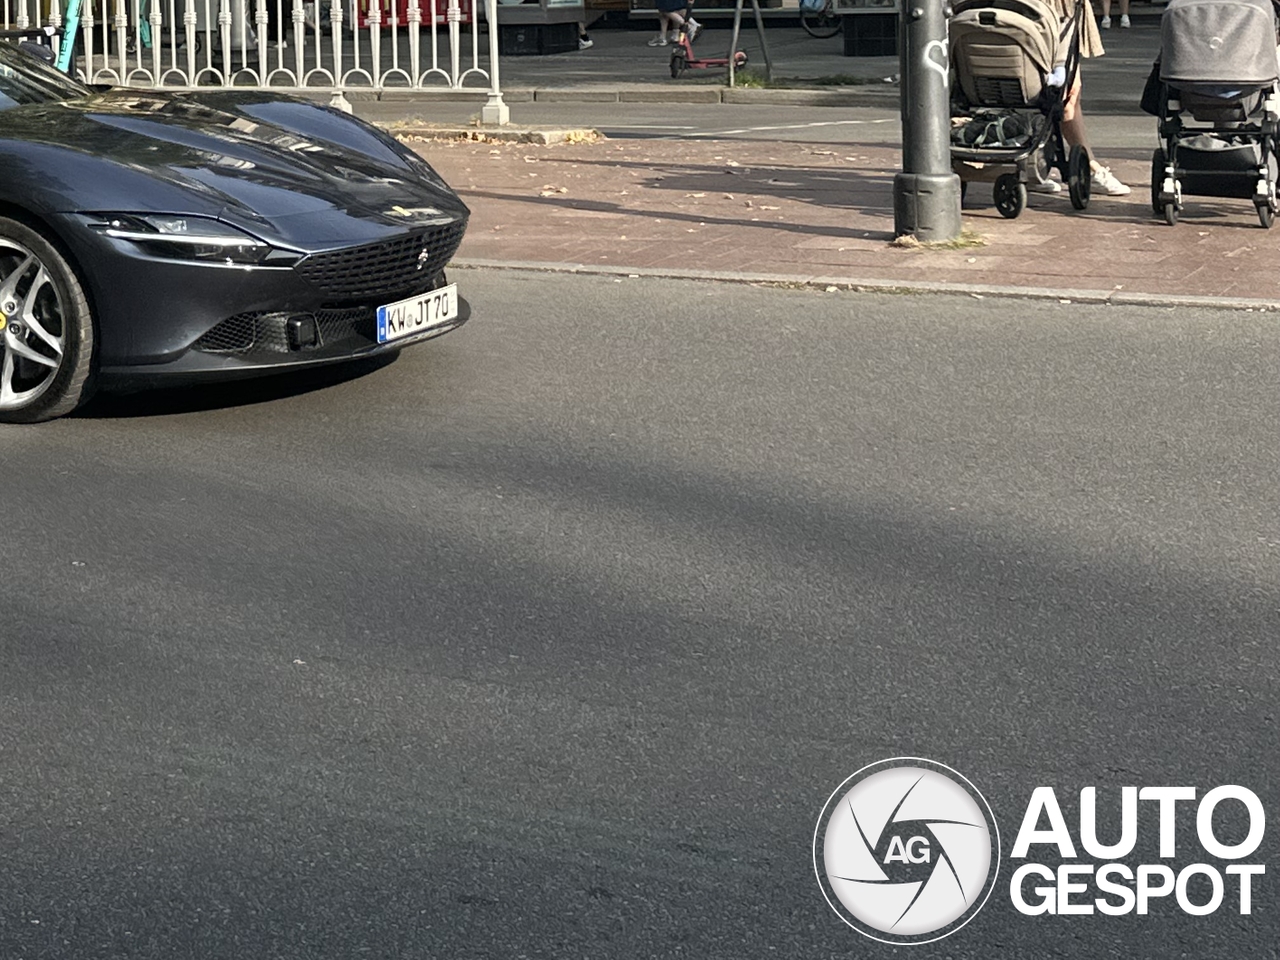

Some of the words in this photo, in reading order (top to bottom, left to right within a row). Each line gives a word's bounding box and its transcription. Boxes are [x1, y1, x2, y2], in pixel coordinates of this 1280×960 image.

[388, 306, 406, 334] KW
[415, 299, 431, 325] JT
[434, 293, 448, 319] 70
